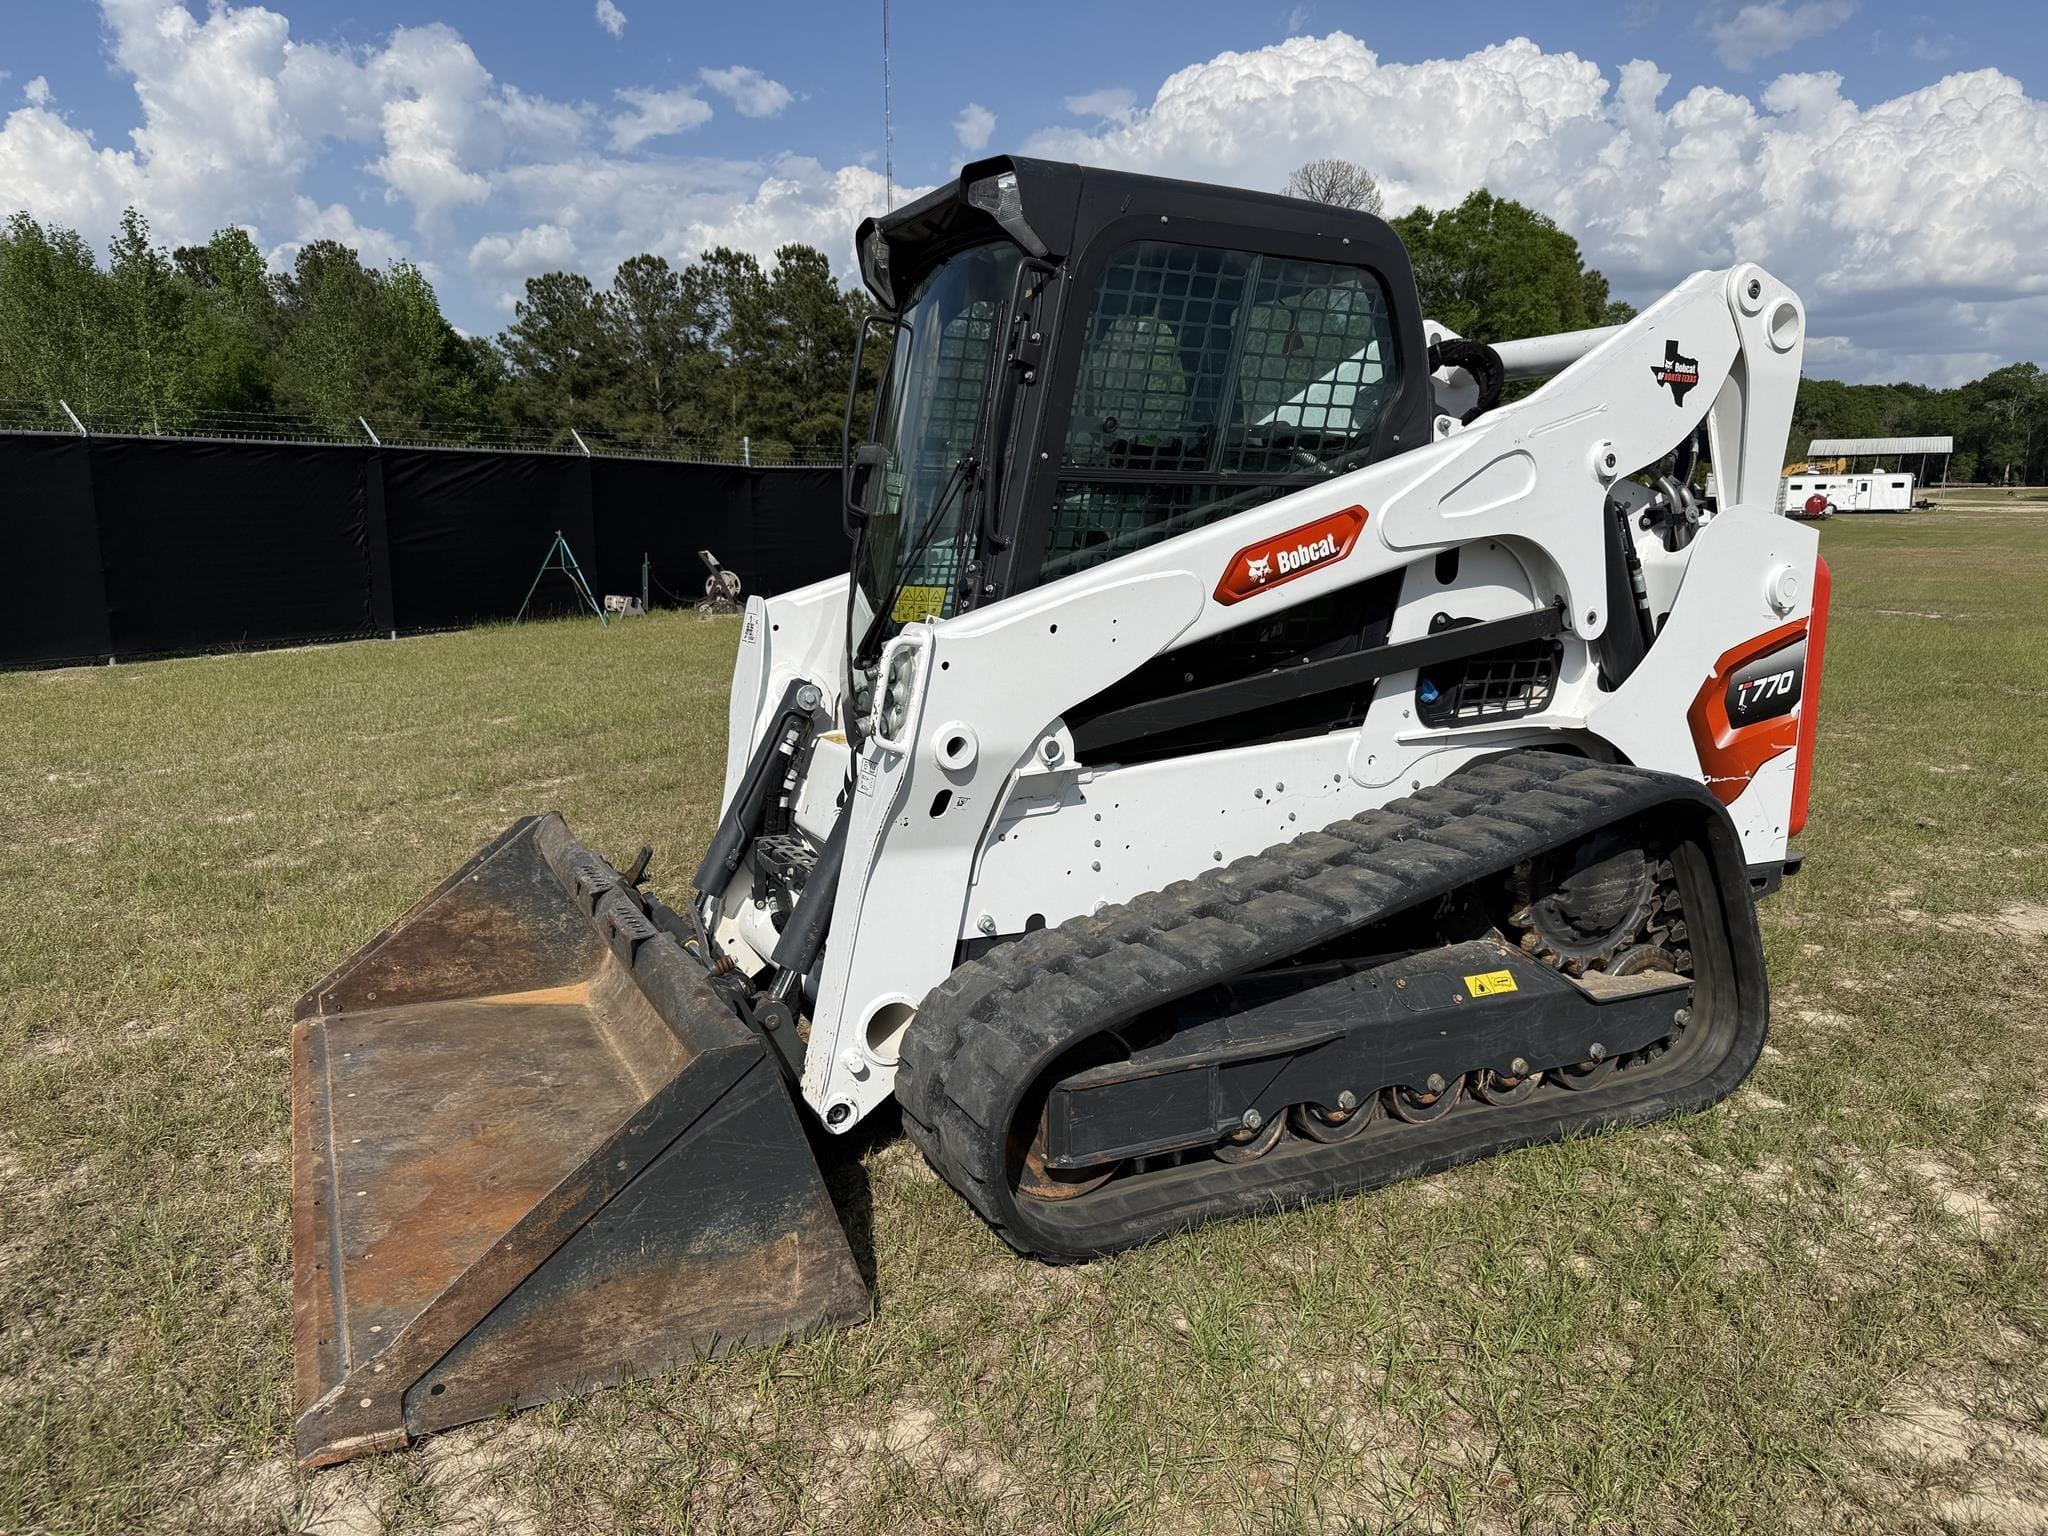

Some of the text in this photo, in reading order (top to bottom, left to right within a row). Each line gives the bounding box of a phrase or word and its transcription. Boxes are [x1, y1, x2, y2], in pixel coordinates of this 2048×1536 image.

[1657, 371, 1697, 383] OF NORTH TEXAS
[1675, 362, 1696, 374] Bobcat
[1277, 533, 1337, 574] Bobcat
[1738, 670, 1794, 713] T770
